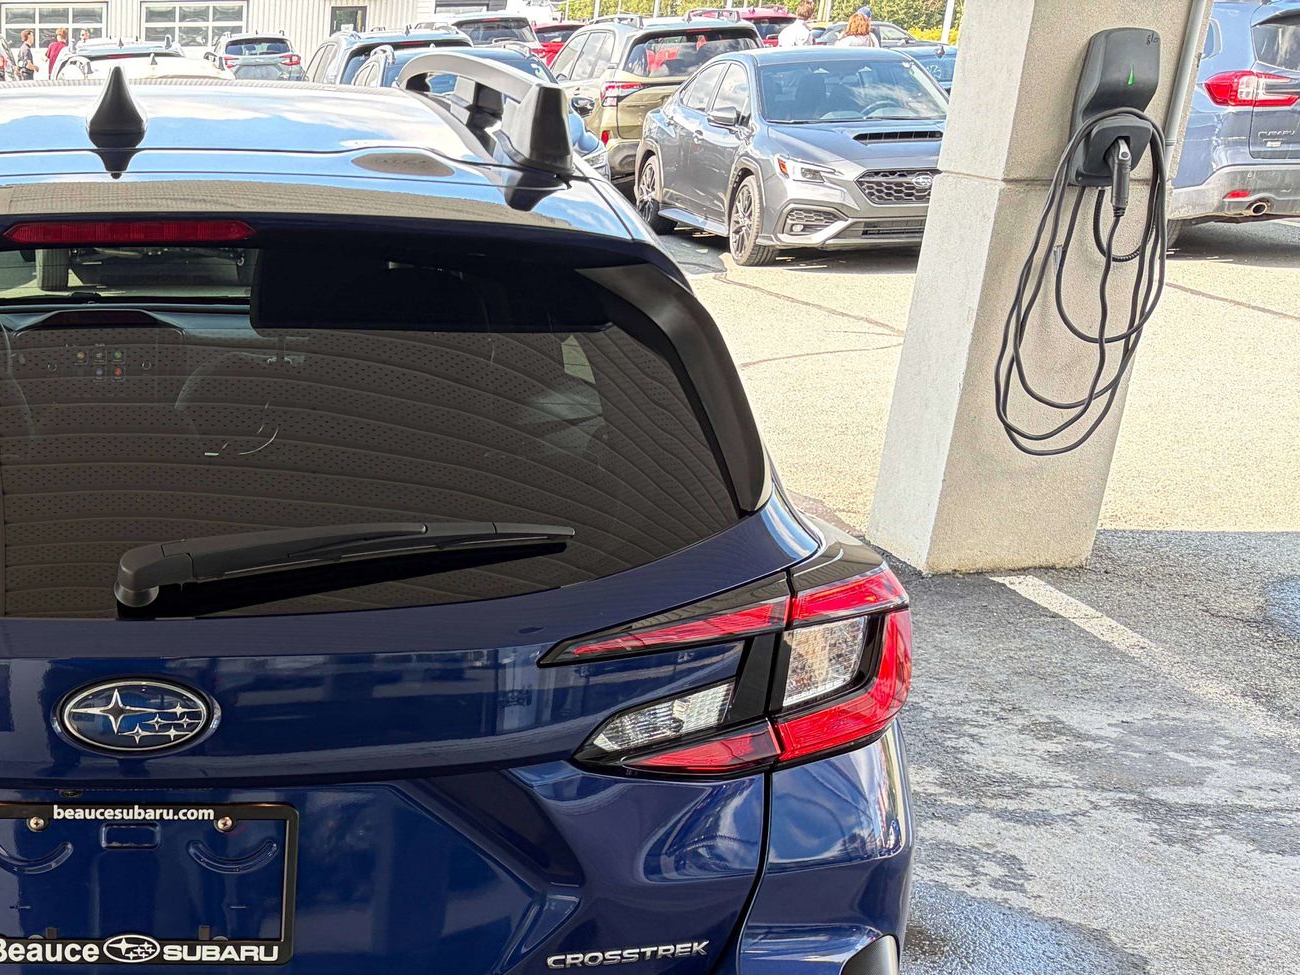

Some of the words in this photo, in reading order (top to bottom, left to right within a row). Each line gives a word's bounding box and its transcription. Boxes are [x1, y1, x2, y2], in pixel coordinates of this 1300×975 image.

[53, 805, 214, 821] beaucesubaru.com
[163, 945, 279, 962] SUBARU
[546, 940, 710, 969] CROSSTREK
